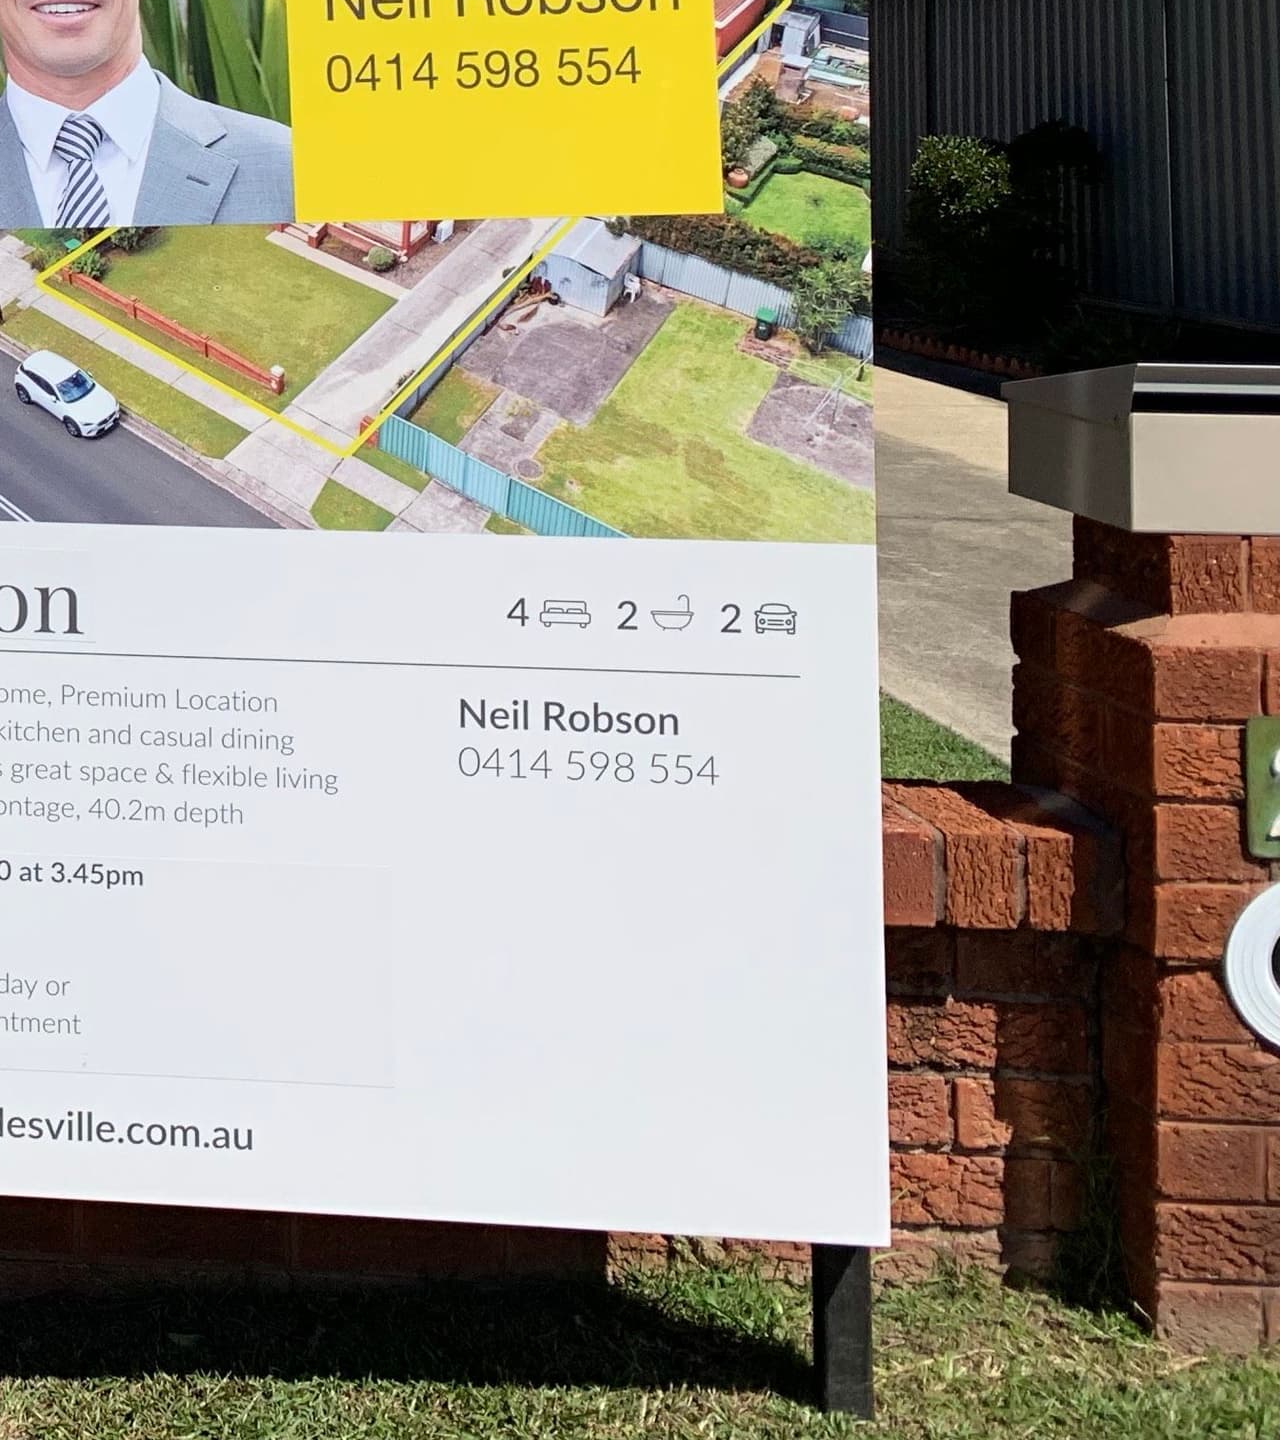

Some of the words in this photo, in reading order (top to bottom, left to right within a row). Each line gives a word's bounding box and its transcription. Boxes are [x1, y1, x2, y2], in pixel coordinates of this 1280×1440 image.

[326, 51, 439, 93] 0414
[455, 48, 540, 90] 598
[557, 45, 642, 87] 554
[506, 597, 530, 627] 4
[616, 600, 639, 631] 2
[720, 603, 742, 634] 2
[61, 683, 167, 710] Premium
[175, 687, 278, 713] Location
[459, 698, 529, 731] Neil
[543, 700, 679, 736] Robson
[87, 723, 132, 745] and
[139, 726, 213, 749] casual
[220, 727, 295, 757] dining
[10, 759, 73, 784] great
[79, 765, 148, 787] space
[155, 762, 175, 785] &
[181, 762, 268, 788] flexible
[276, 766, 339, 796] living
[458, 746, 553, 780] 0414
[566, 750, 635, 783] 598
[649, 752, 720, 787] 554
[87, 797, 166, 822] 40.2m
[173, 800, 244, 829] depth
[18, 862, 44, 883] at
[50, 861, 144, 890] 3.45pm
[45, 979, 71, 997] or
